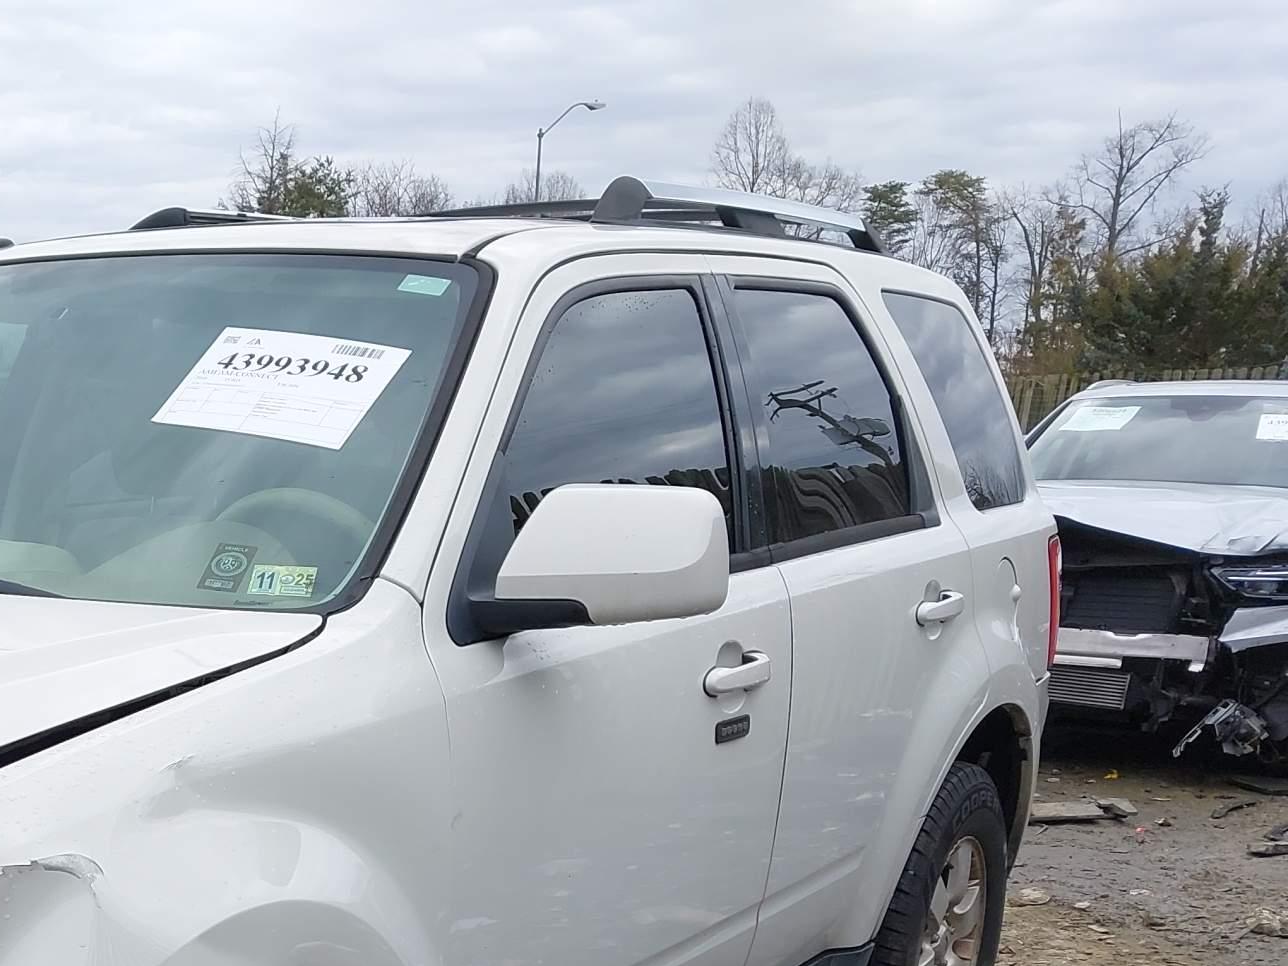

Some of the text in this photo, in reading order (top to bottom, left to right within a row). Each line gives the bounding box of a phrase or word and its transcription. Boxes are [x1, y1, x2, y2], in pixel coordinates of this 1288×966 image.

[217, 352, 369, 384] 43993948
[256, 571, 275, 590] 11
[294, 573, 314, 586] 25
